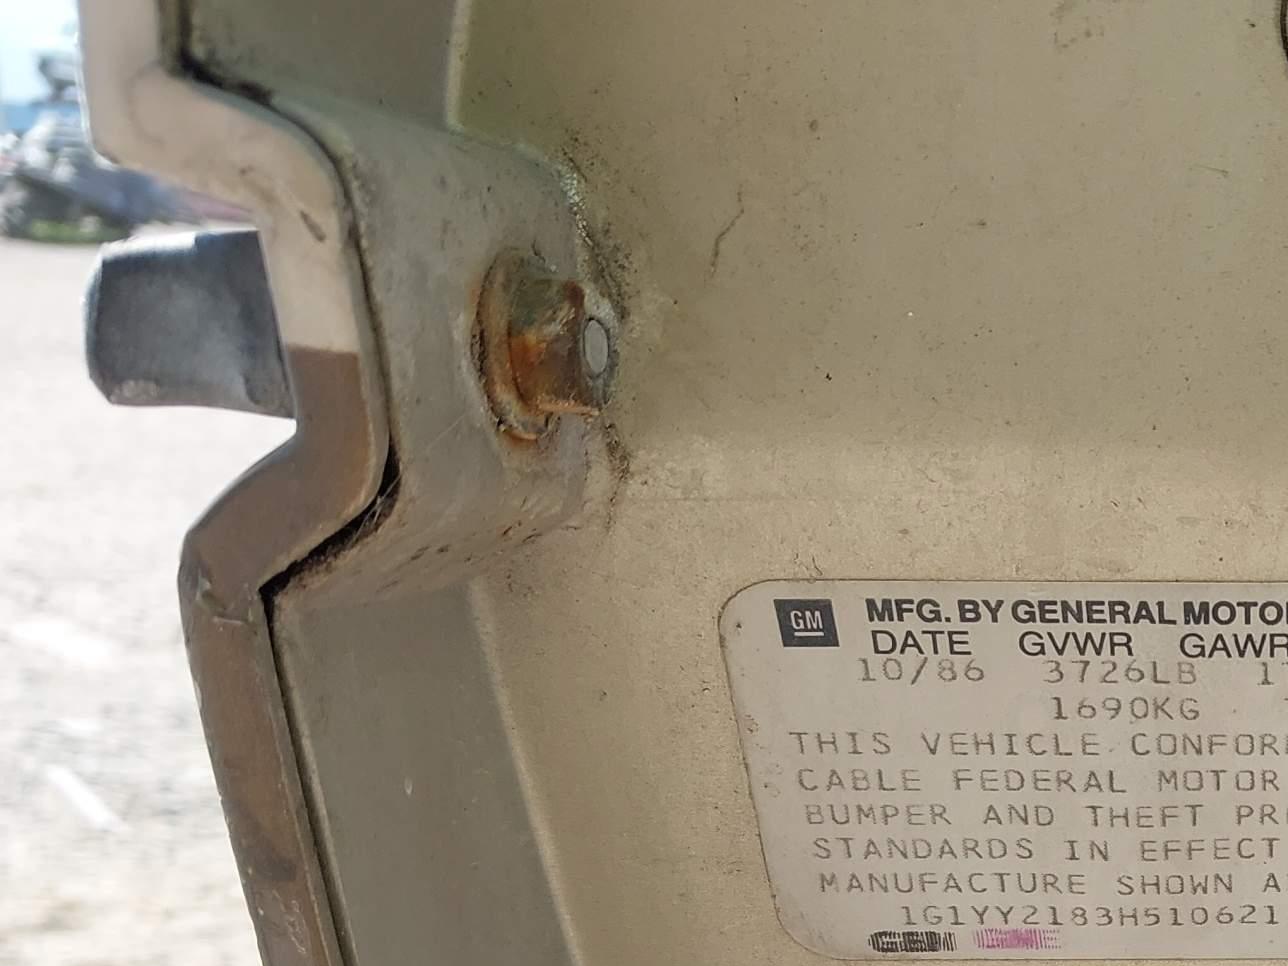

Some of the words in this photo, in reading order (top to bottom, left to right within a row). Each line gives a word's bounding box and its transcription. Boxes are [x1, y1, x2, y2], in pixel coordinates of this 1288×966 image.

[790, 609, 824, 630] GM
[867, 599, 952, 624] MFG.
[959, 600, 1002, 624] BY
[1012, 600, 1177, 625] GENERAL
[872, 630, 972, 655] DATE
[1019, 631, 1134, 657] GVWR
[857, 658, 985, 685] 10/86
[1043, 659, 1197, 685] 3726LB
[1053, 697, 1201, 721] 1690KG
[790, 731, 891, 757] THIS
[921, 732, 1100, 757] VEHICLE
[799, 768, 922, 792] CABLE
[953, 769, 1127, 792] FEDERAL
[1157, 769, 1281, 792] MOTOR
[805, 803, 952, 827] BUMPER
[983, 804, 1055, 827] AND
[1086, 804, 1204, 829] THEFT
[812, 837, 1035, 861] STANDARDS
[1064, 839, 1111, 862] IN
[1140, 838, 1280, 862] EFFECT
[820, 872, 1088, 895] MANUFACTURE
[1115, 872, 1234, 896] SHOWN
